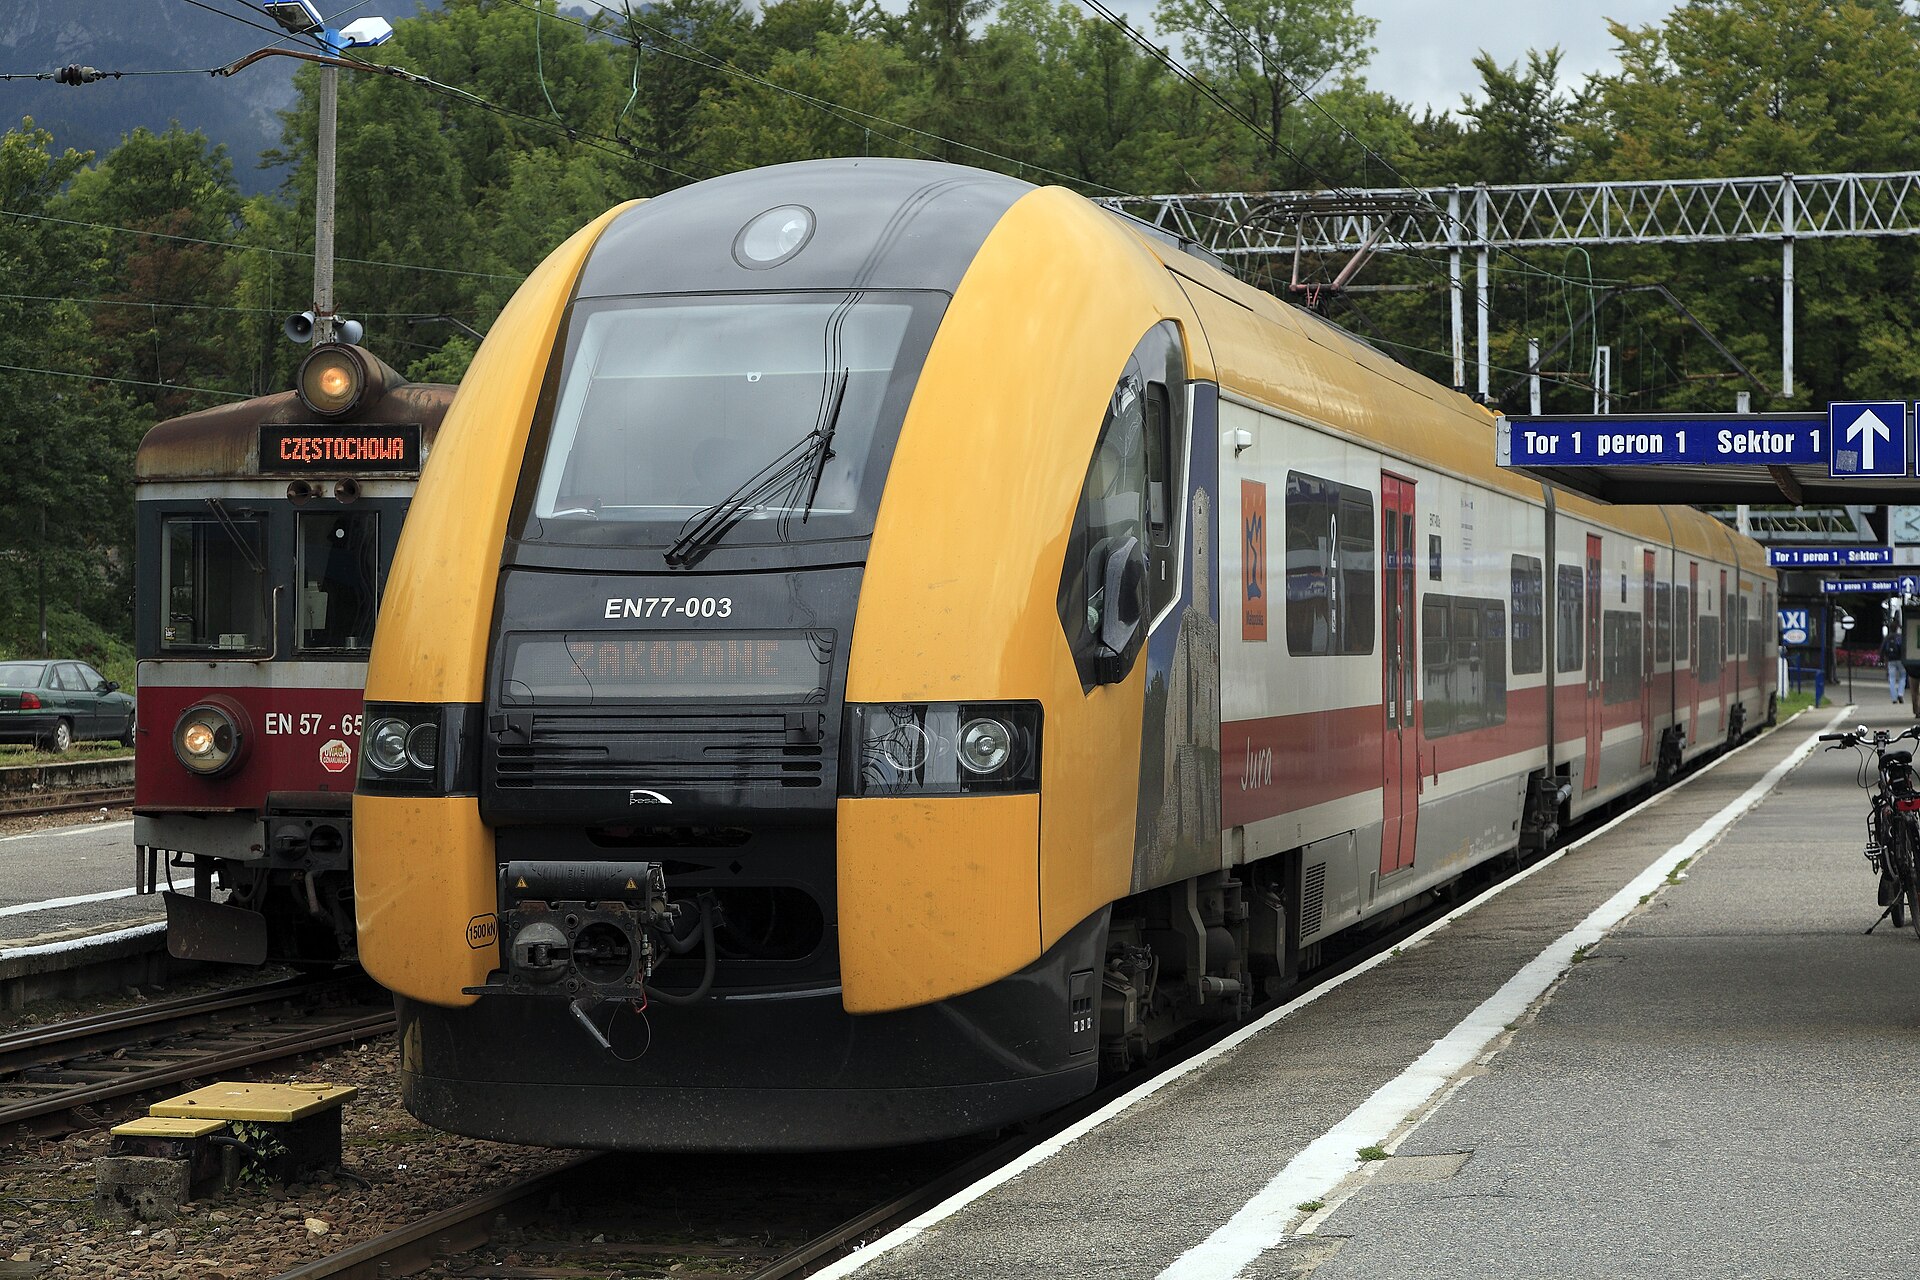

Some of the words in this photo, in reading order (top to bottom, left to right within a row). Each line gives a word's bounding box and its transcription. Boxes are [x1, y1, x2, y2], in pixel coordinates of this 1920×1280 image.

[280, 437, 404, 463] CZĘSTOCHOWA
[1524, 431, 1559, 454] Tor
[1571, 431, 1582, 454] 1
[1597, 433, 1663, 457] peron
[1675, 430, 1686, 454] 1
[1717, 429, 1795, 454] Sektor
[1809, 429, 1820, 453] 1
[1775, 551, 1790, 562] Tor
[1793, 551, 1799, 562] 1
[1802, 552, 1830, 563] peron
[1832, 551, 1838, 562] 1
[1848, 550, 1880, 562] Sektor
[1883, 550, 1889, 561] 1
[604, 597, 733, 619] EN77-003
[570, 640, 779, 676] ZAKOPANE
[265, 712, 293, 735] EN
[299, 713, 323, 735] 57
[1240, 735, 1272, 791] Jura
[469, 924, 486, 940] 1500
